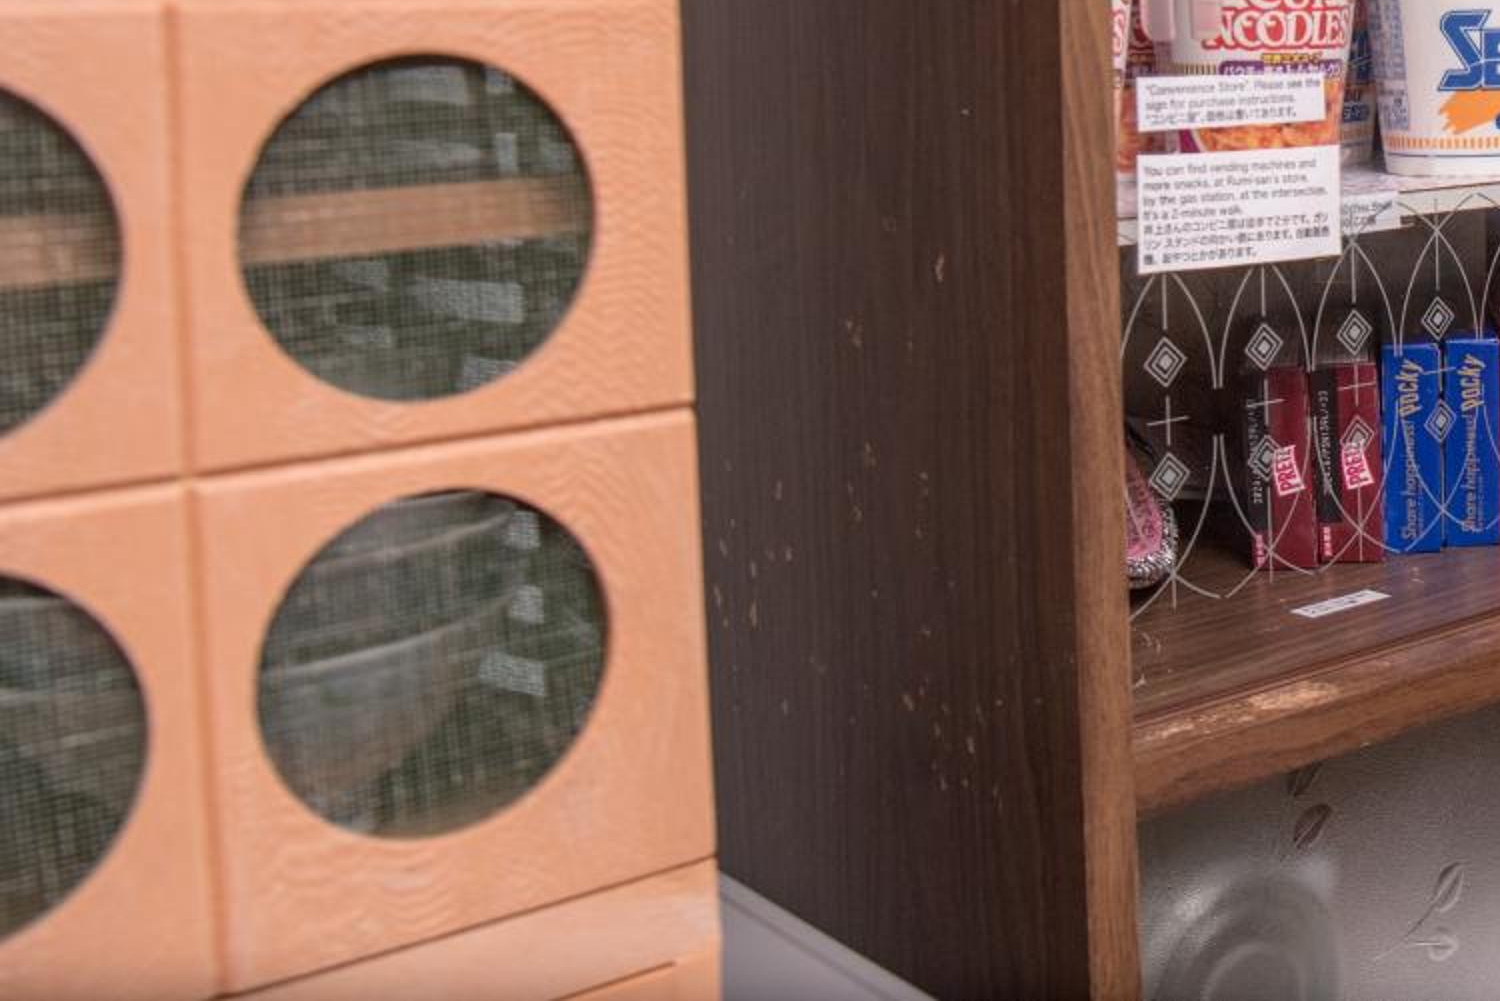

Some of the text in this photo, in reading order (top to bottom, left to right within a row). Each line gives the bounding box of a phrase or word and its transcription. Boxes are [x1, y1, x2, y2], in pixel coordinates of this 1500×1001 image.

[1304, 77, 1321, 88] the
[1169, 98, 1187, 108] for
[1144, 158, 1317, 176] You can find vending machines and
[1143, 181, 1172, 192] more
[1213, 177, 1225, 187] at
[1143, 196, 1157, 208] by
[1159, 194, 1178, 205] the
[1180, 195, 1198, 206] gas
[1239, 190, 1250, 200] at
[1251, 189, 1269, 199] the
